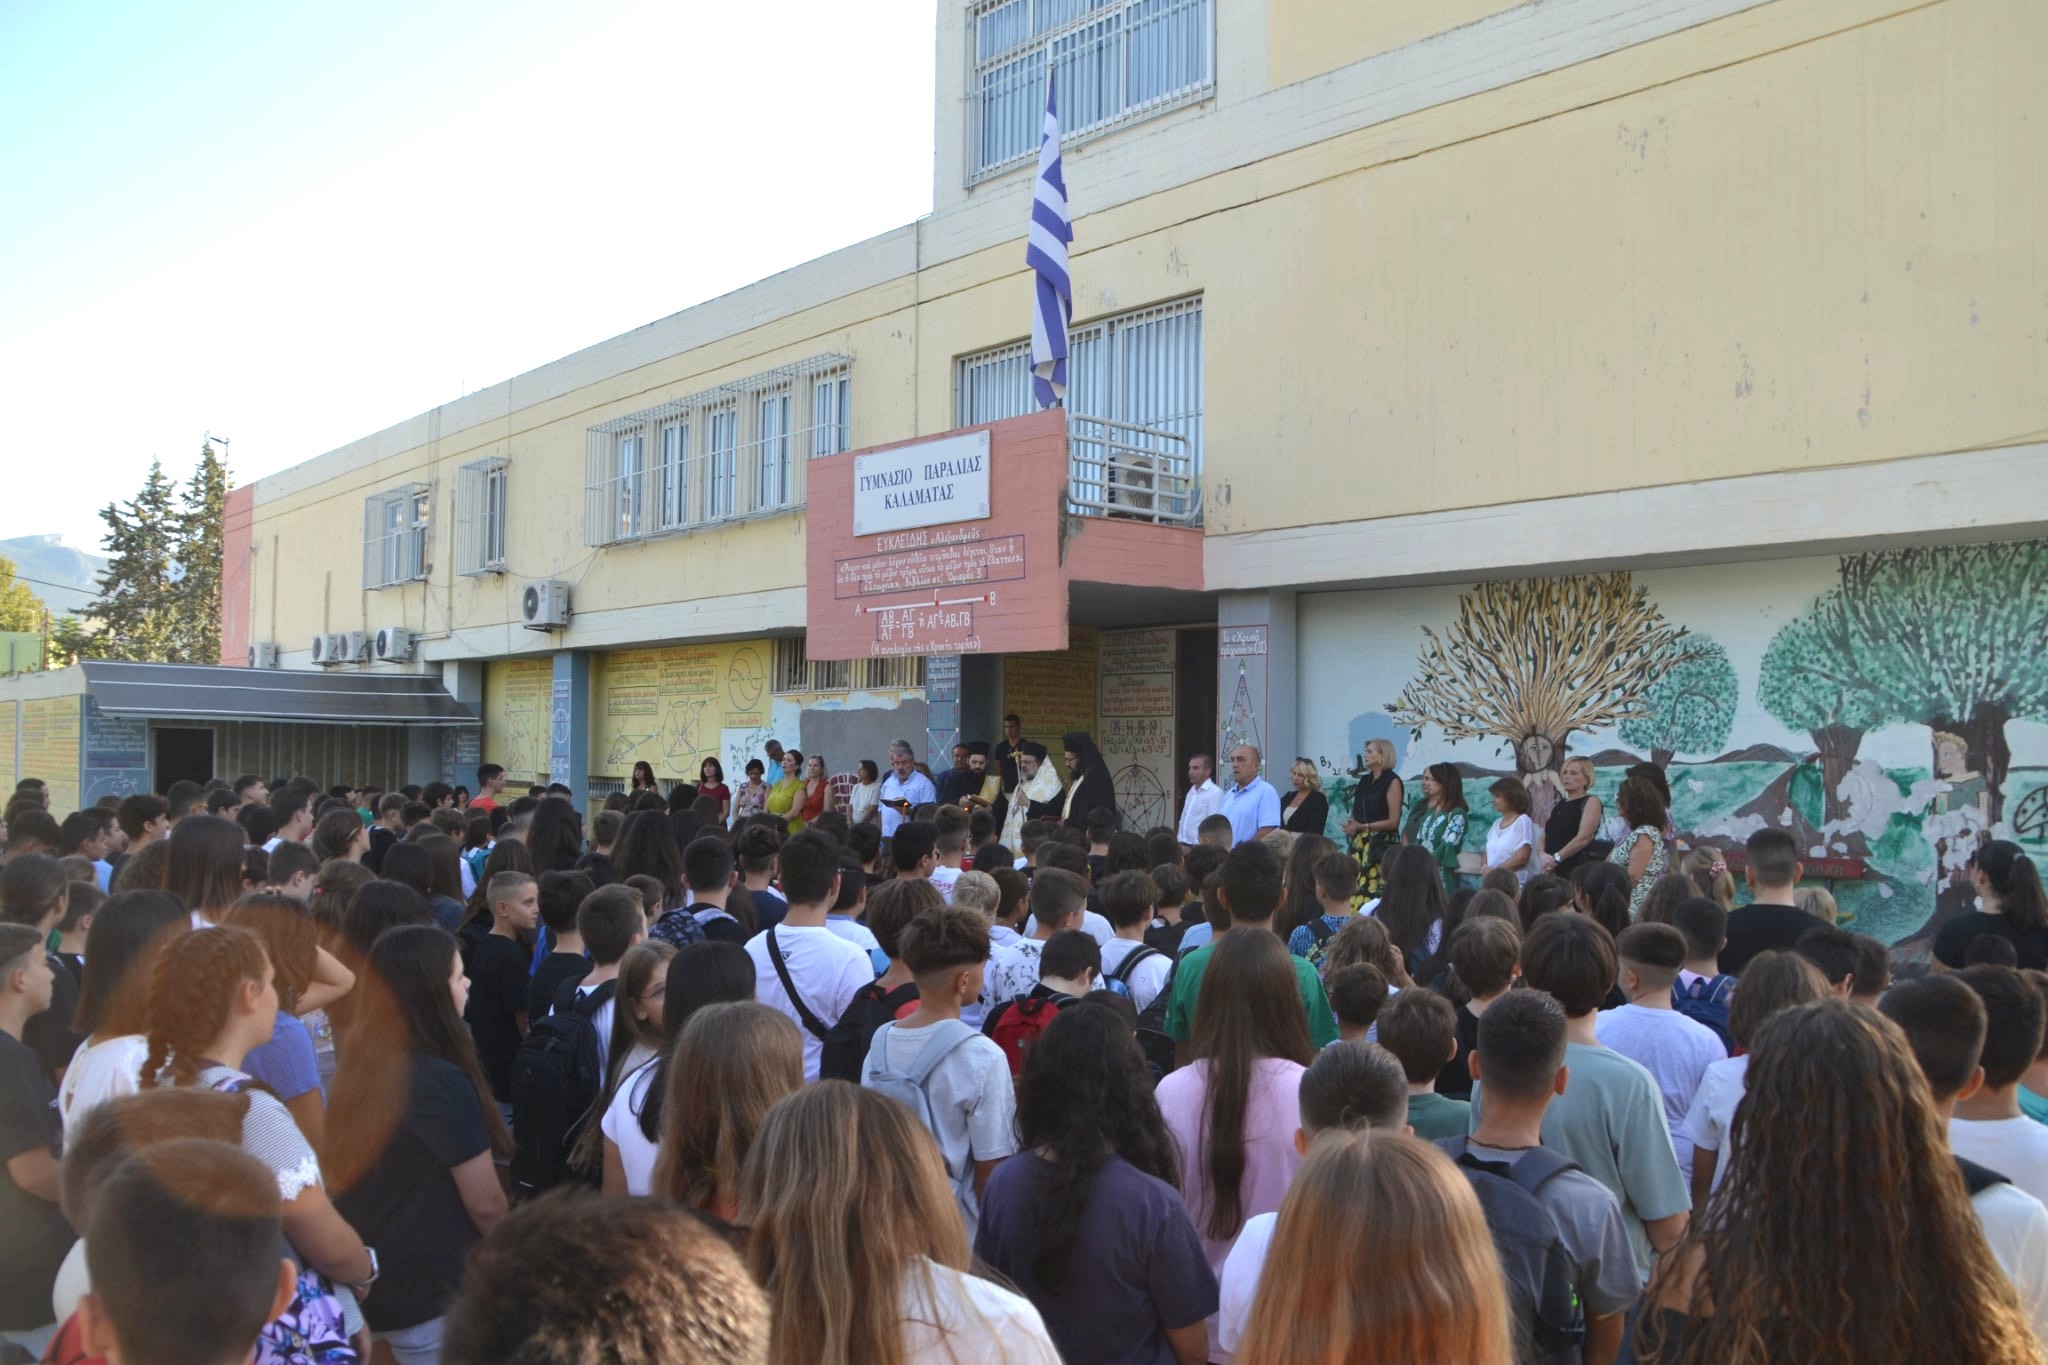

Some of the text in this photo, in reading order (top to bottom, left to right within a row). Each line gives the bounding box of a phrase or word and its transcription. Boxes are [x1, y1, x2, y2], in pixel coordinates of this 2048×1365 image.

[860, 455, 981, 492] ΓΥΜΝΑΣΙΟ ΠΑΡΑΛΙΑΣ
[884, 483, 954, 510] ΚΑΛΑΜΑΤΑΣ
[877, 530, 928, 552] ΕΥΚΛΕΙΔΗΣ
[990, 591, 997, 606] Β
[855, 603, 862, 616] Α
[881, 611, 895, 625] ΑΒ
[902, 608, 916, 622] ΑΓ
[881, 625, 915, 640] ΑΓ ΓΒ
